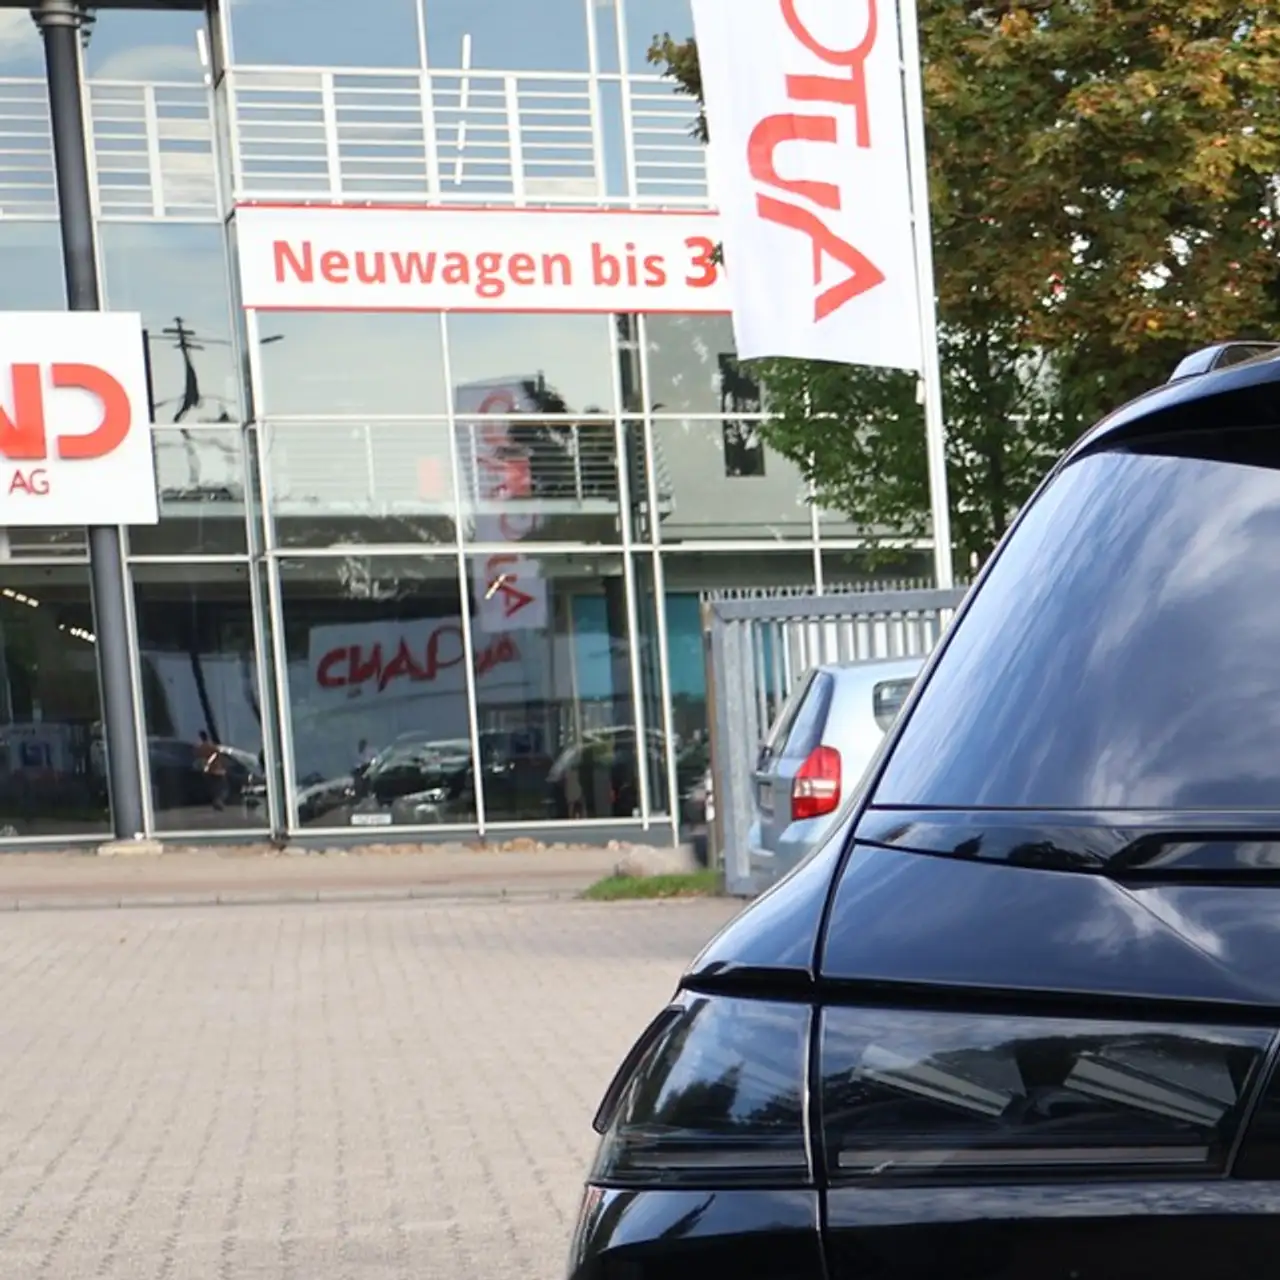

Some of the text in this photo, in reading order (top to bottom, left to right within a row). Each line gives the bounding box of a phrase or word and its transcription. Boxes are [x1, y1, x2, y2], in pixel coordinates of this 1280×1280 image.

[273, 236, 726, 298] Neuwagen bis 3
[9, 469, 49, 495] AG
